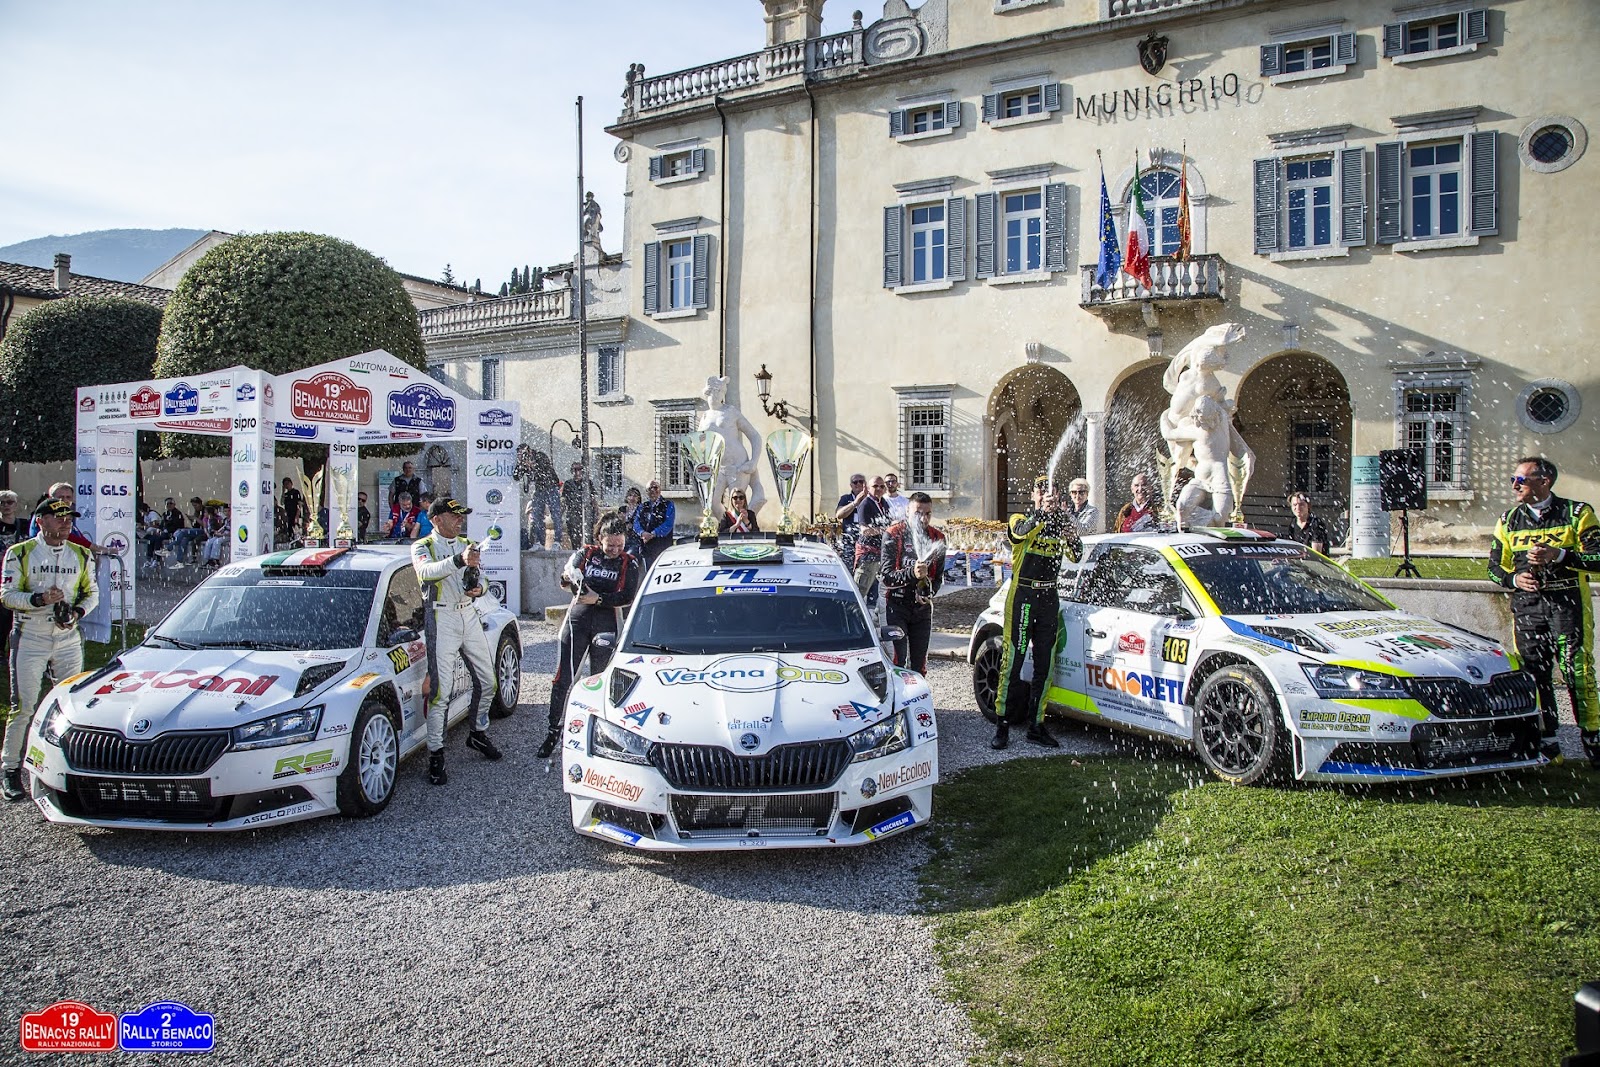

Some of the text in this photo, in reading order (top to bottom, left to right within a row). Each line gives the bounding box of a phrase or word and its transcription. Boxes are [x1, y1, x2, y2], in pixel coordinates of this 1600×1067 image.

[1076, 73, 1238, 119] MUNICIPIO
[350, 360, 409, 376] DAYTONA RACE
[295, 388, 369, 414] BENACVS RALLY
[325, 411, 360, 420] NAZIONALE
[390, 400, 453, 421] RALLY BENACO
[234, 413, 256, 431] sipro
[333, 441, 356, 454] sipro
[476, 434, 513, 452] sipro
[234, 444, 256, 463] ecoblu
[476, 460, 514, 477] ecoblu
[1512, 531, 1564, 546] HRX
[1178, 545, 1206, 555] 103
[1216, 546, 1300, 555] By BIANCHI
[220, 567, 244, 576] 106
[586, 565, 618, 580] freem
[655, 572, 682, 585] 102
[809, 579, 838, 587] freem
[1165, 638, 1187, 664] 103
[391, 647, 409, 672] 106
[662, 667, 844, 683] Verona One
[1086, 664, 1184, 704] TECNORETI
[186, 690, 224, 698] DETAILS
[902, 693, 929, 707] SPOTUP
[624, 702, 646, 714] EURO
[849, 700, 880, 720] A
[1300, 710, 1370, 723] EMPORIO DEGANI
[728, 721, 767, 730] farfalla
[274, 749, 334, 774] RS
[879, 760, 932, 791] New-Ecology
[98, 782, 200, 802] DELTA
[584, 768, 644, 802] New-Ecology
[881, 817, 909, 833] MICHELIN
